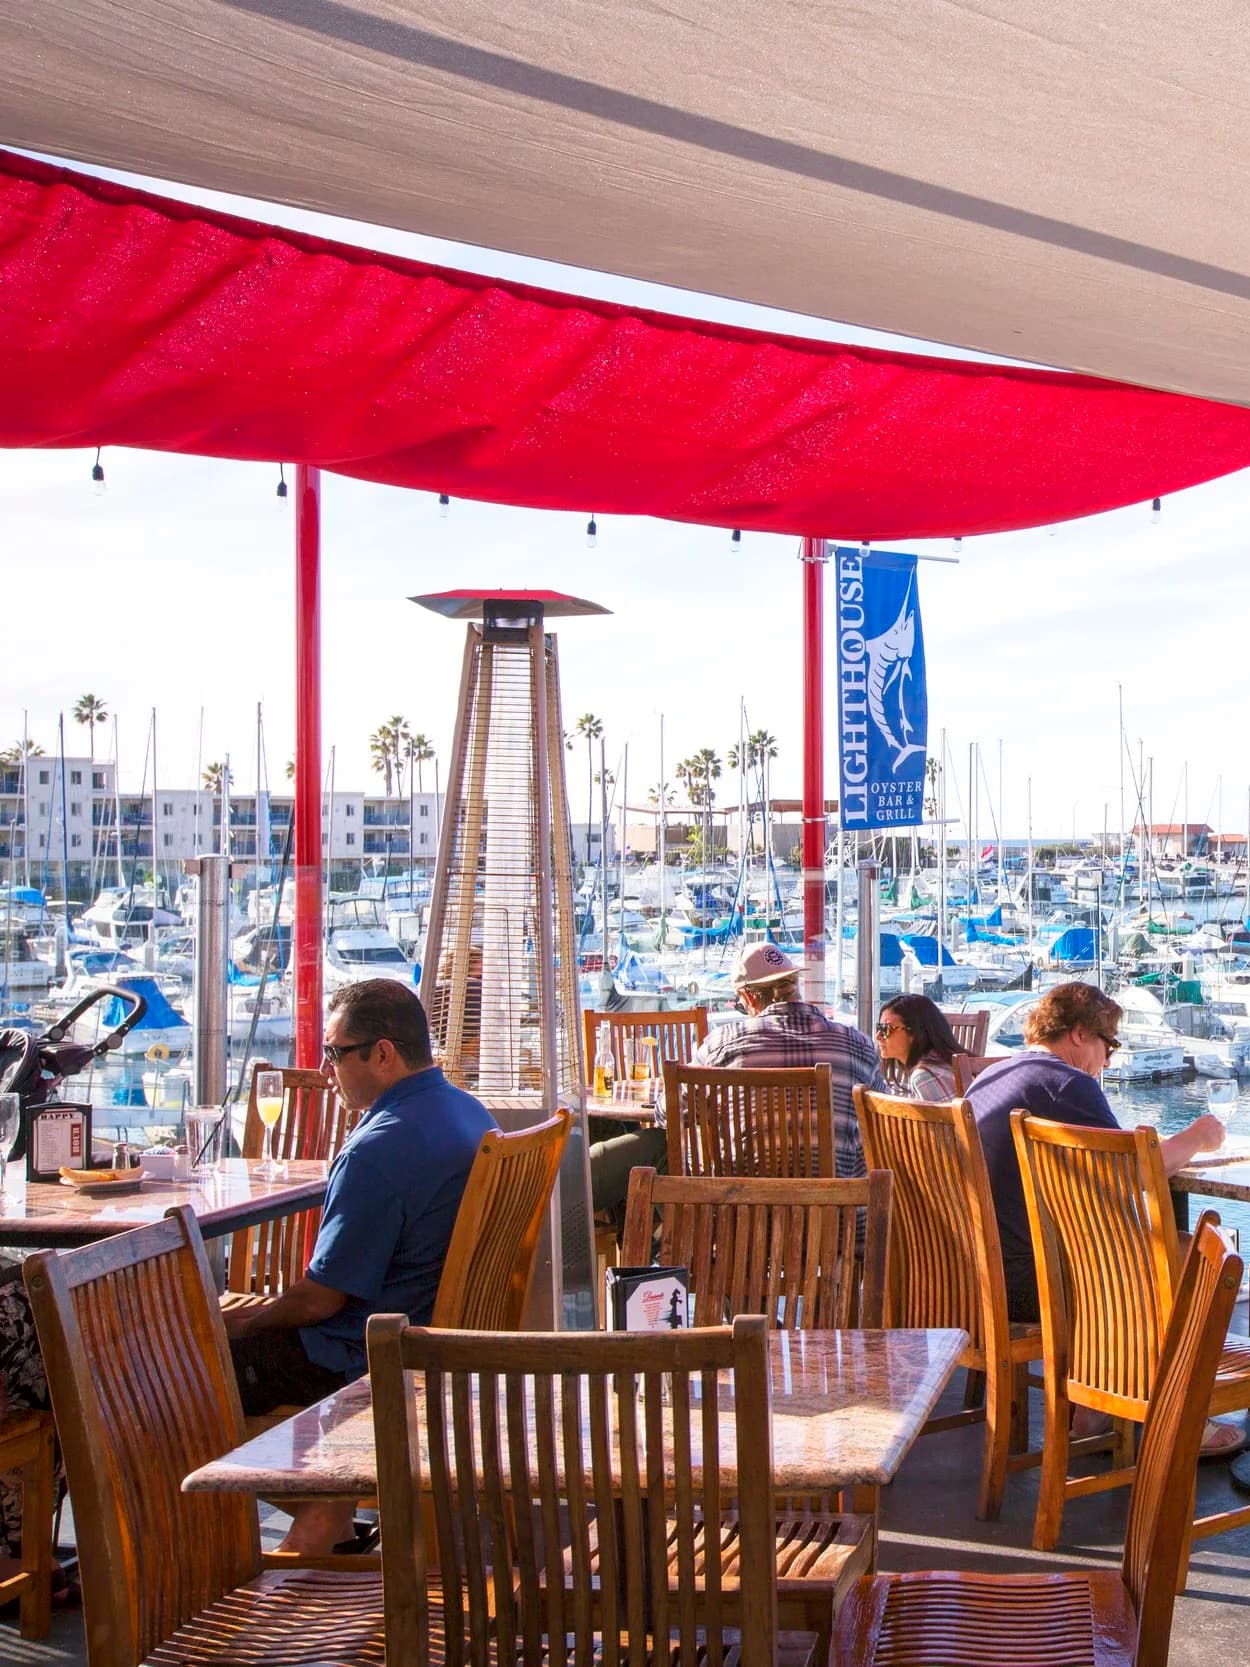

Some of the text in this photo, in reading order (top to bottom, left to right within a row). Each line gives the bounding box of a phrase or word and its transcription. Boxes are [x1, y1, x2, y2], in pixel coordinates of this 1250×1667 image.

[840, 555, 868, 824] LIGHTHOUSE
[871, 781, 922, 794] OYSTER
[878, 794, 915, 807] BAR &
[876, 808, 915, 821] GRILL
